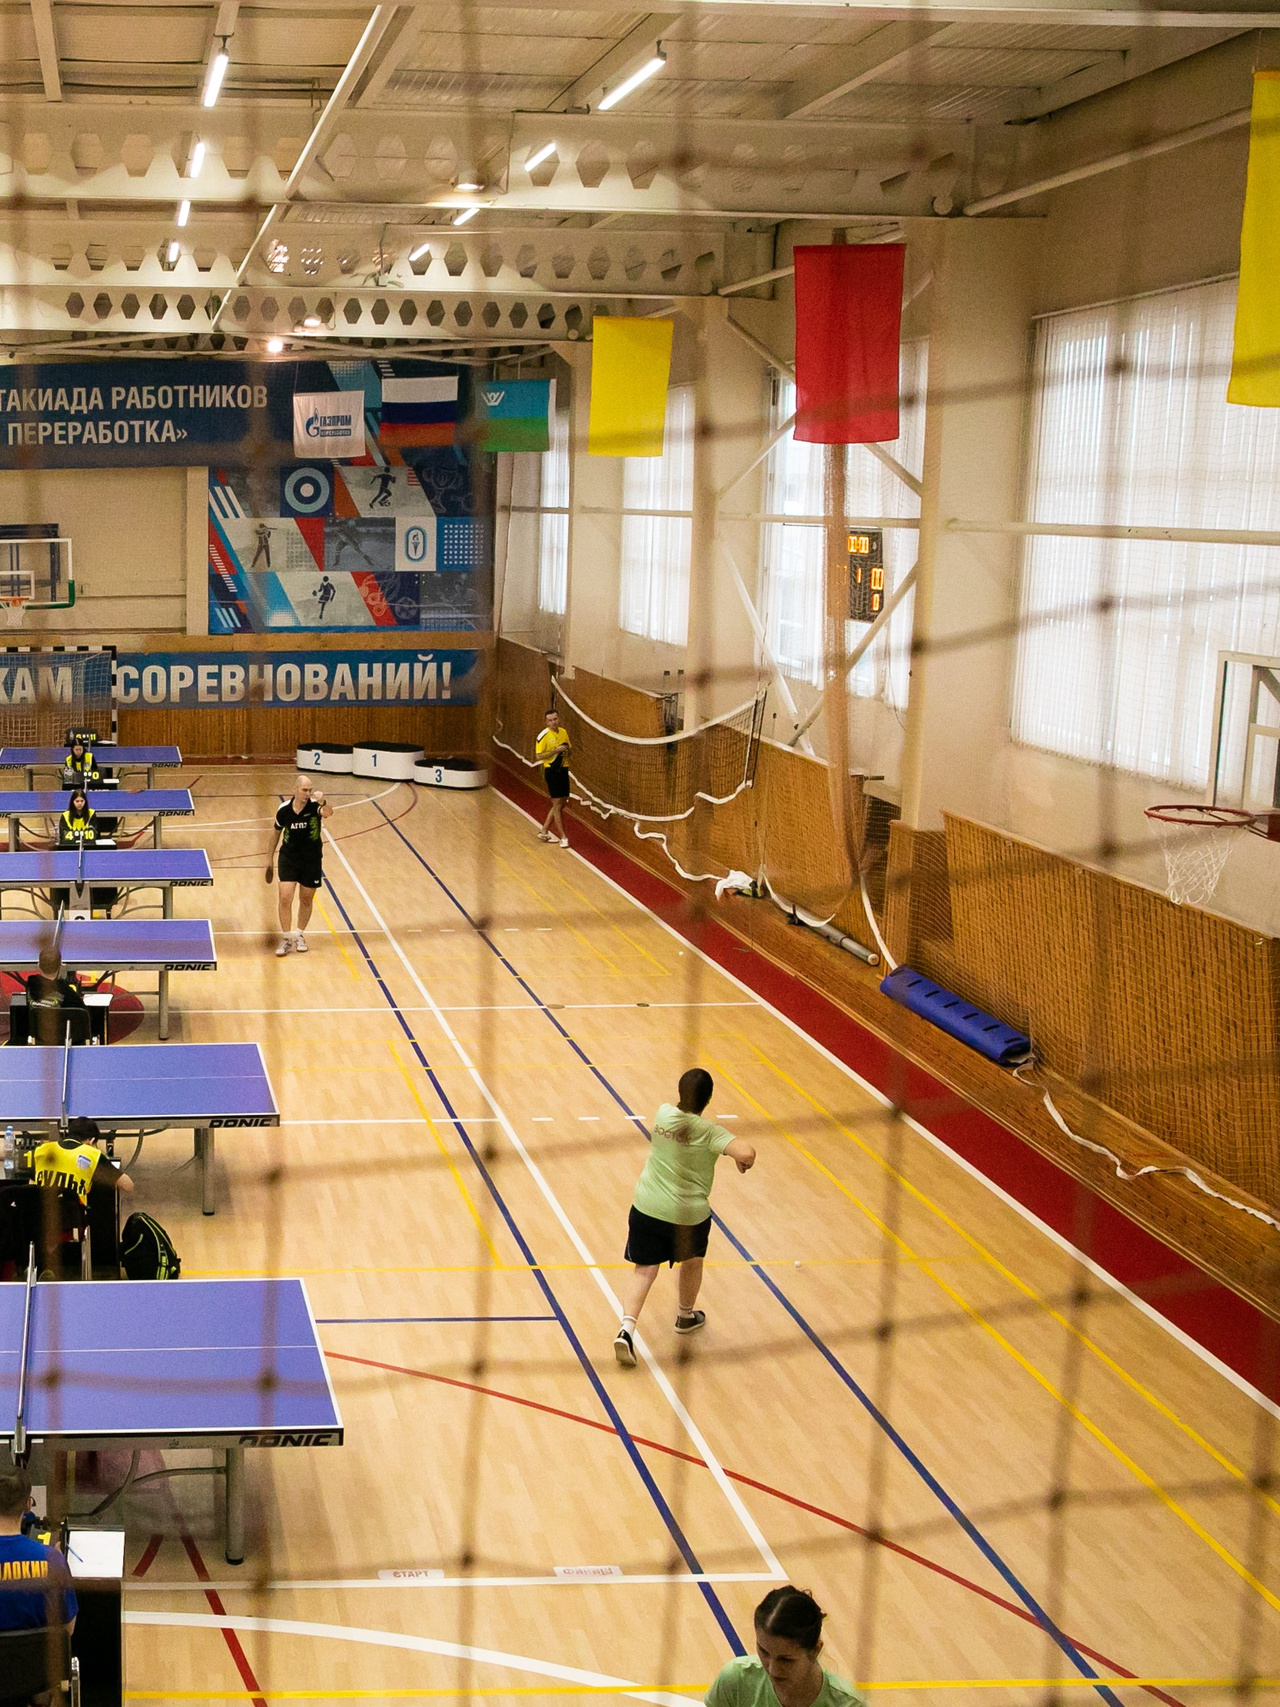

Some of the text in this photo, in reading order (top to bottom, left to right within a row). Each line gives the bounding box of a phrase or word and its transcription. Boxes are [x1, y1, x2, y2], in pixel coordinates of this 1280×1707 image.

[111, 384, 267, 410] РАБОТНИКОВ
[320, 414, 352, 427] ГАЗПРОМ
[8, 420, 188, 446] ПЕРЕРАБОТКА»
[117, 653, 452, 704] СОРЕВНОВАНИЙ!
[314, 752, 321, 765] 2
[372, 754, 377, 767] 1
[435, 769, 442, 783] 3
[209, 1119, 273, 1128] DONIC
[393, 1570, 429, 1578] СТАРТ
